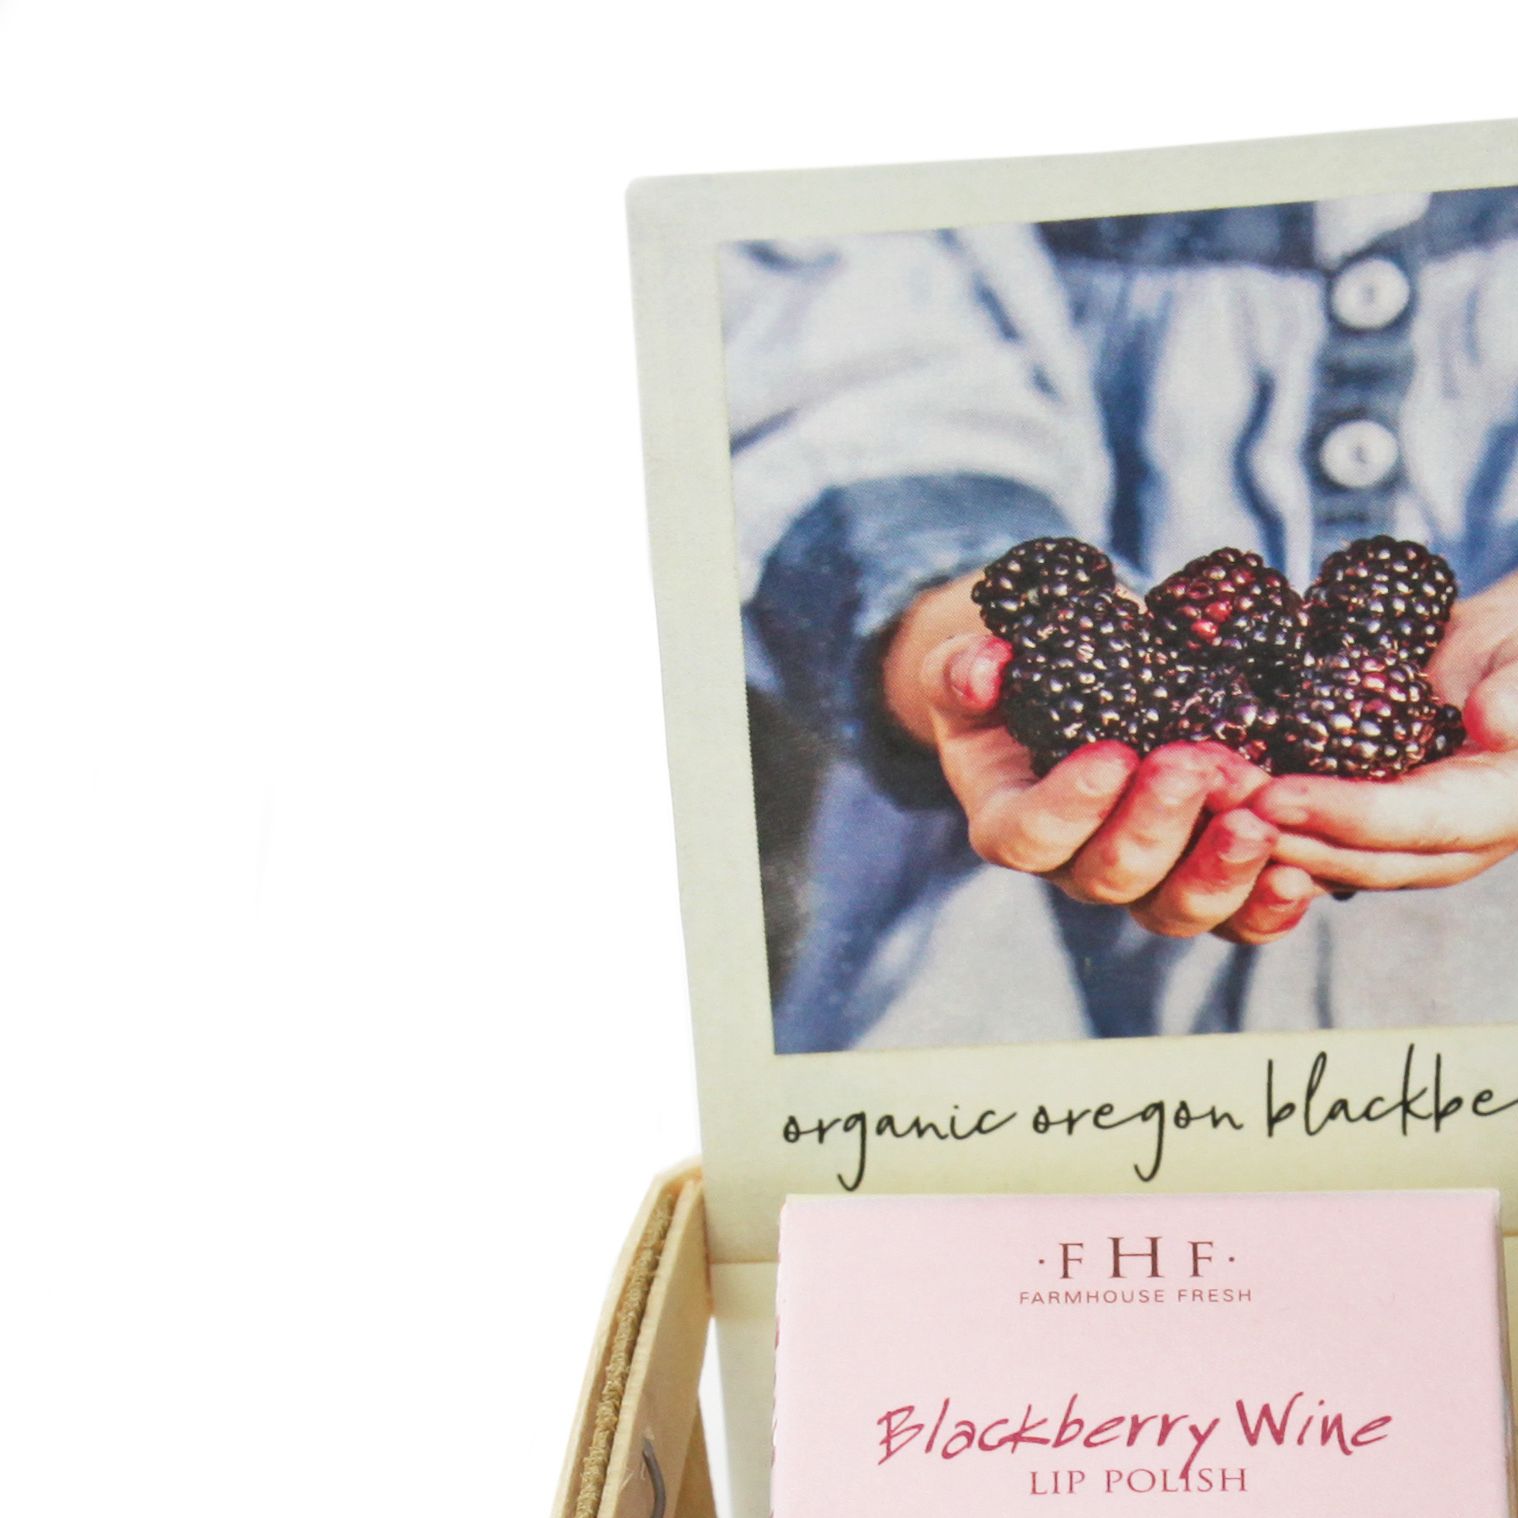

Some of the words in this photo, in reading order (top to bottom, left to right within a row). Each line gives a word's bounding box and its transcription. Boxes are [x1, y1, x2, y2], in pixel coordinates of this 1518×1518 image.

[783, 1103, 1017, 1191] organic
[1032, 1096, 1244, 1183] oregon
[1018, 1290, 1166, 1305] FARMHOUSE
[1177, 1288, 1254, 1303] FRESH
[876, 1392, 1221, 1482] Blackberry
[1234, 1391, 1395, 1456] Wine
[1030, 1468, 1086, 1496] LIP
[1105, 1466, 1248, 1494] POLISH
